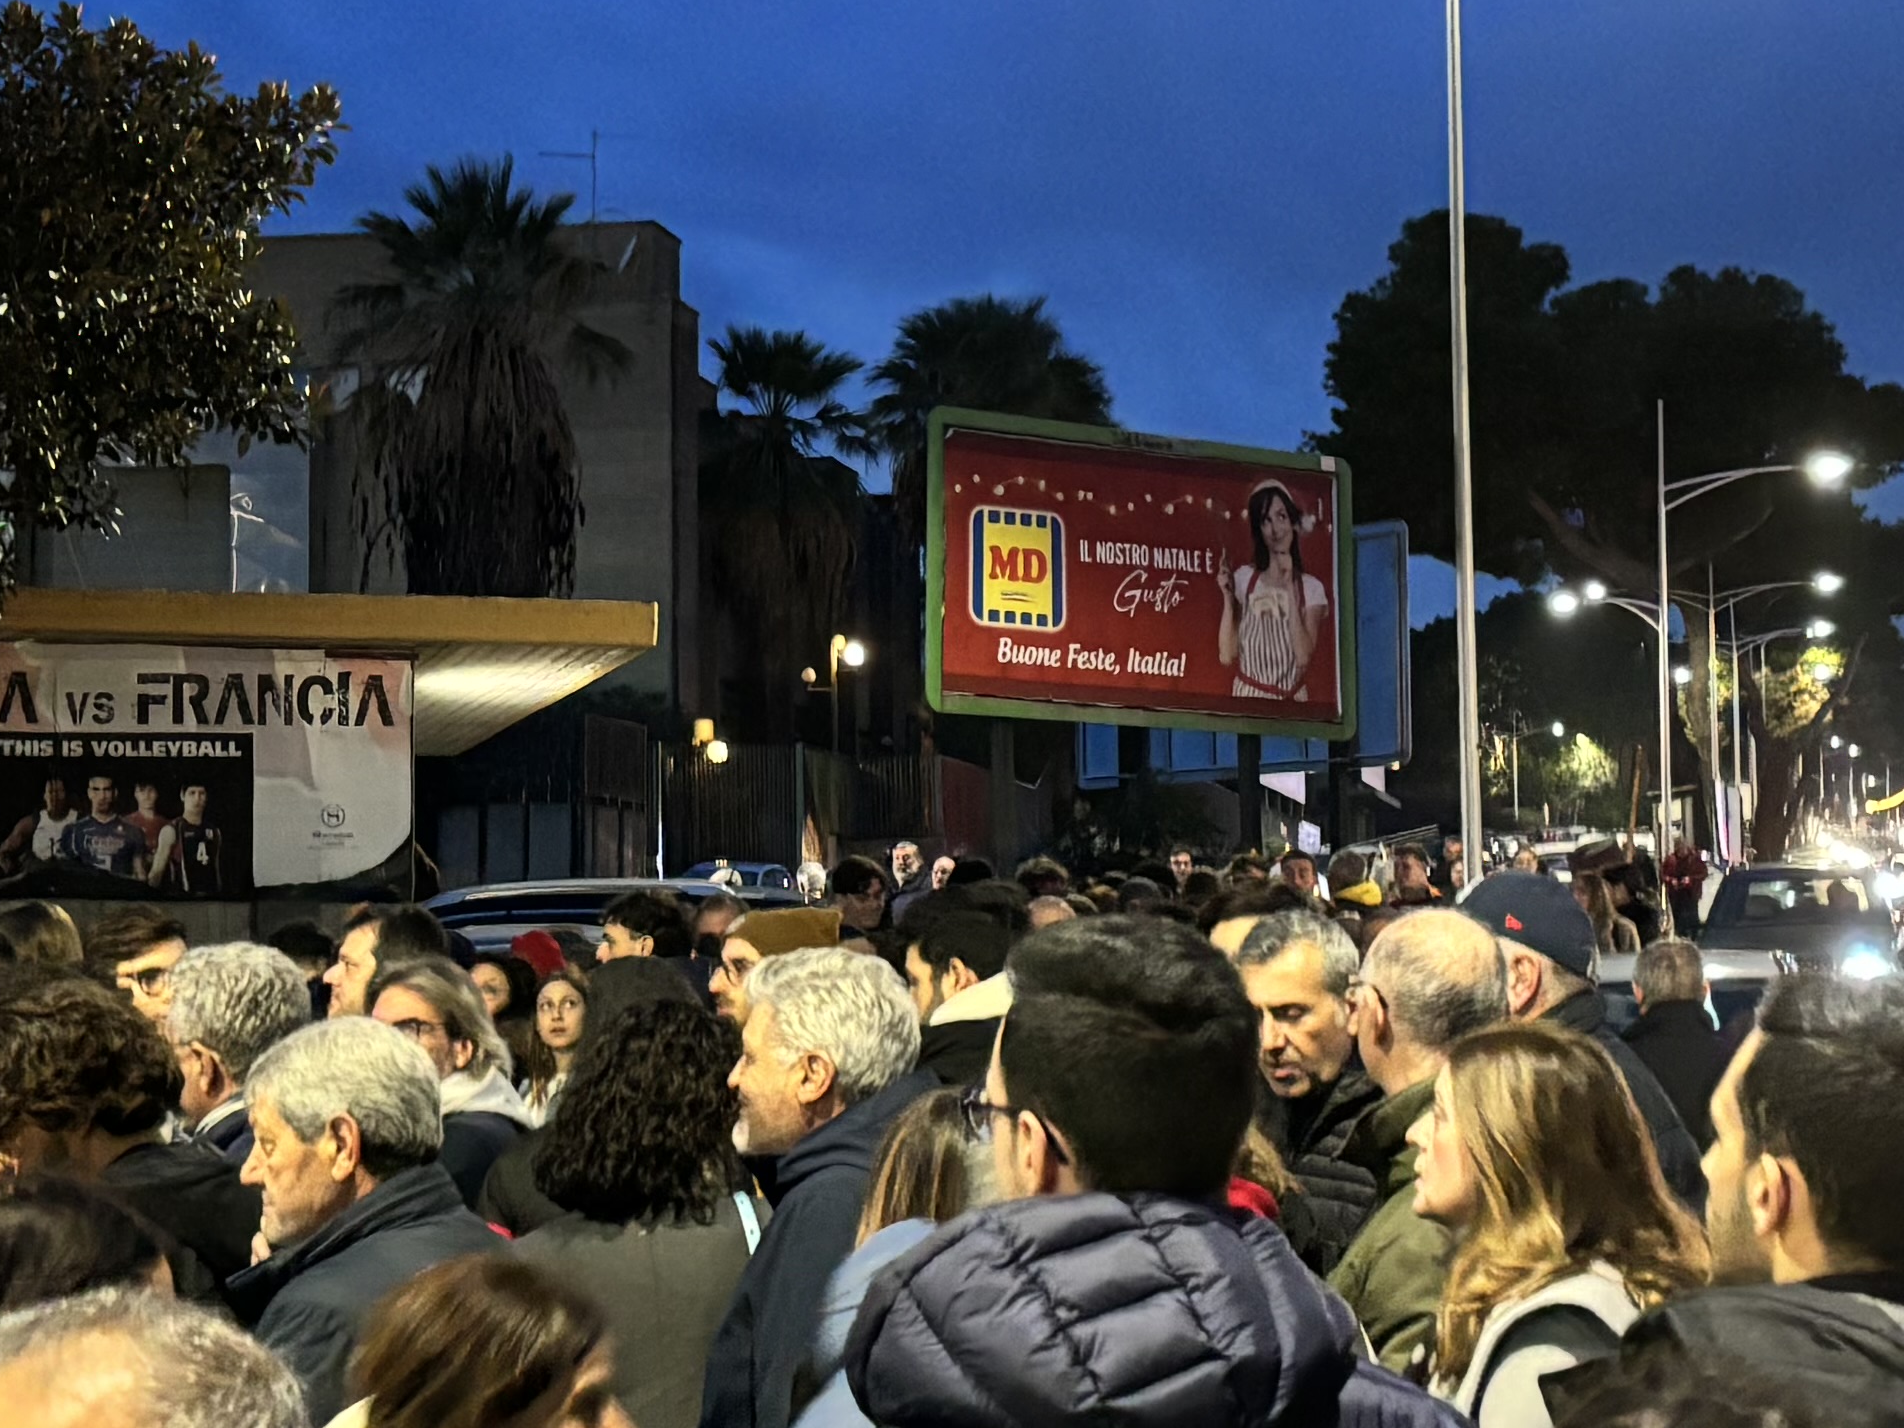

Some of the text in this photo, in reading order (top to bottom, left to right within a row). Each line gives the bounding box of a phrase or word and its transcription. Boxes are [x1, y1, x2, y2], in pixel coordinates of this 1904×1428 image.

[989, 545, 1047, 584] MD
[1080, 539, 1092, 563] IL
[1096, 541, 1148, 566] NOSTRO
[1153, 547, 1201, 573] NATALE
[1113, 569, 1189, 618] Gusto
[997, 637, 1187, 677] Buone Feste, Italia!
[136, 671, 395, 727] FRANCIA
[0, 739, 242, 758] THIS IS VOLLEYBALL
